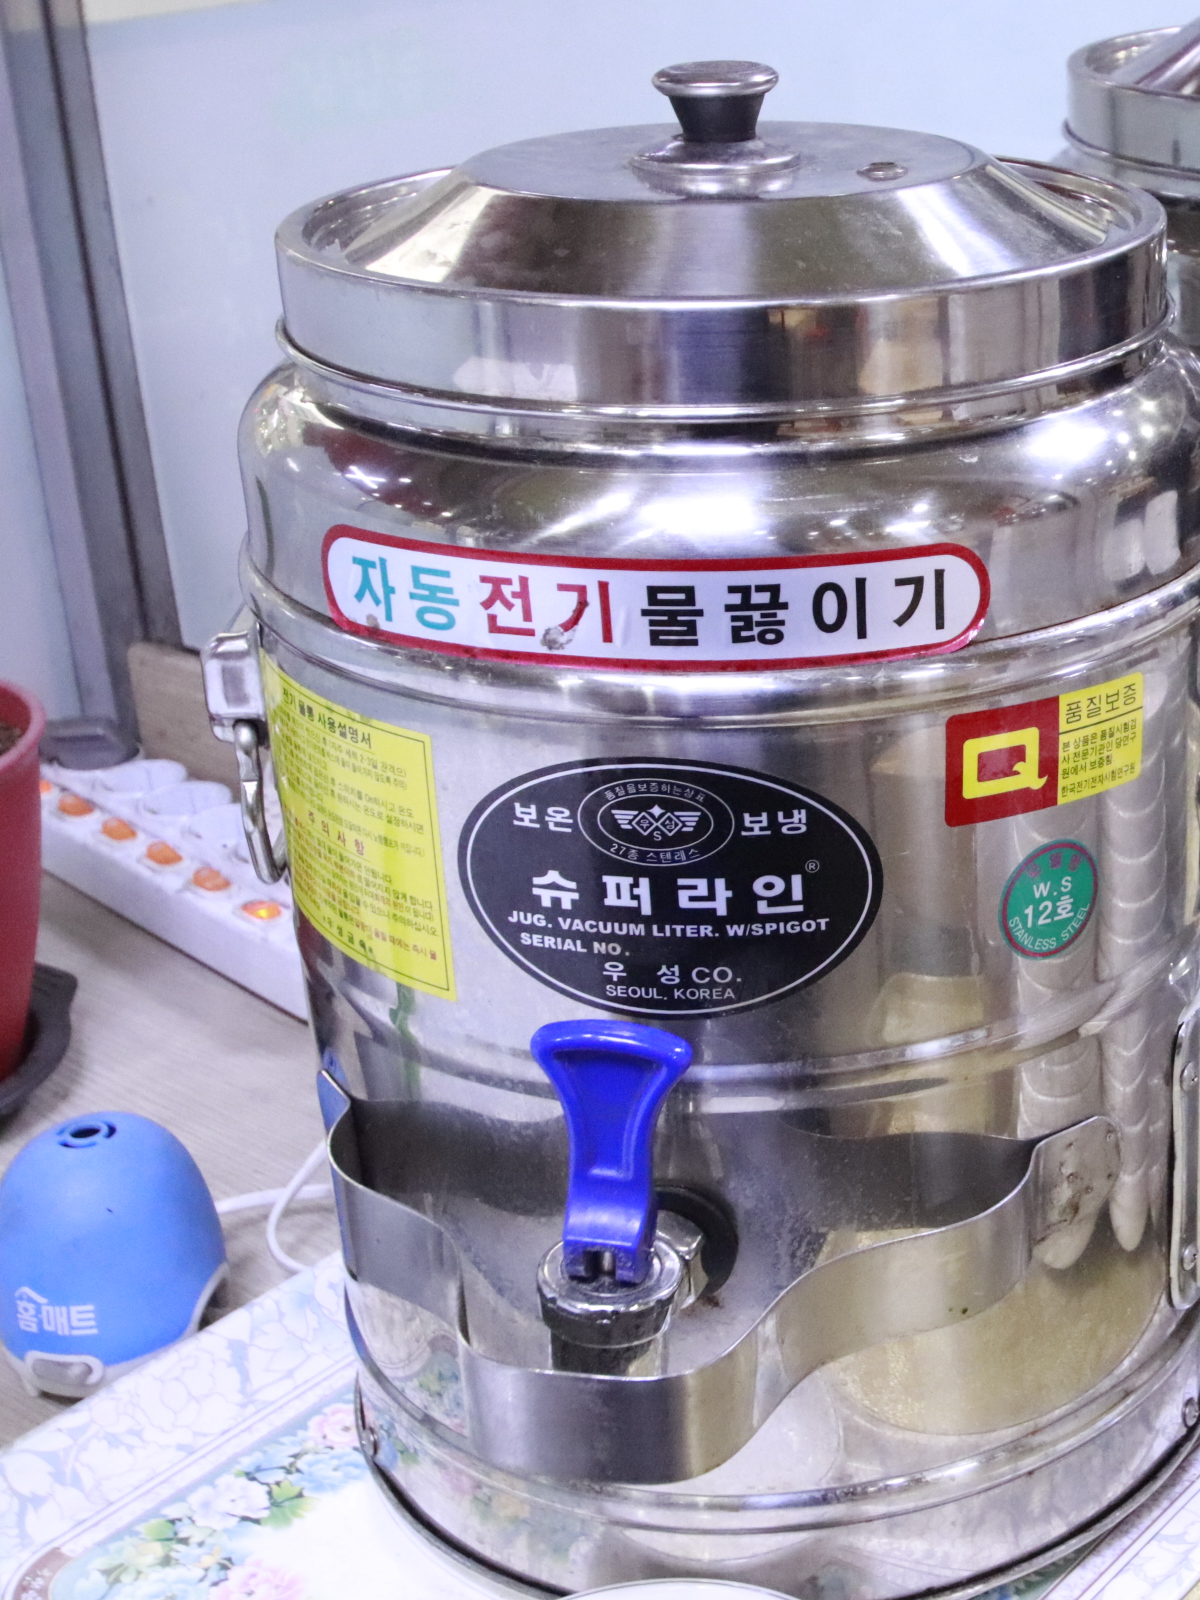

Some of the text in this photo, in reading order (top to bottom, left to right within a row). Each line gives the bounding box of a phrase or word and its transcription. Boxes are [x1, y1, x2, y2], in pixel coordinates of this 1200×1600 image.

[1066, 683, 1136, 724] 품질보증
[282, 687, 295, 710] 전기
[317, 709, 371, 750] 사용설명서
[1062, 754, 1070, 765] 사
[1073, 740, 1113, 763] 전문기관인
[1073, 732, 1098, 750] 상품은
[962, 726, 1048, 800] Q
[1061, 762, 1087, 779] 원에서
[513, 802, 573, 833] 보온
[741, 809, 807, 836] 보냉
[653, 831, 662, 841] S
[646, 849, 700, 863] 스텐레스
[508, 910, 830, 938] JUG. VACUUM LITER. W/SPIGOT
[1024, 895, 1074, 928] 12호
[1009, 903, 1090, 950] STANLESS STEEL
[520, 932, 630, 957] SERIAL NO.
[691, 966, 741, 984] CO.
[674, 987, 735, 1000] KOREA
